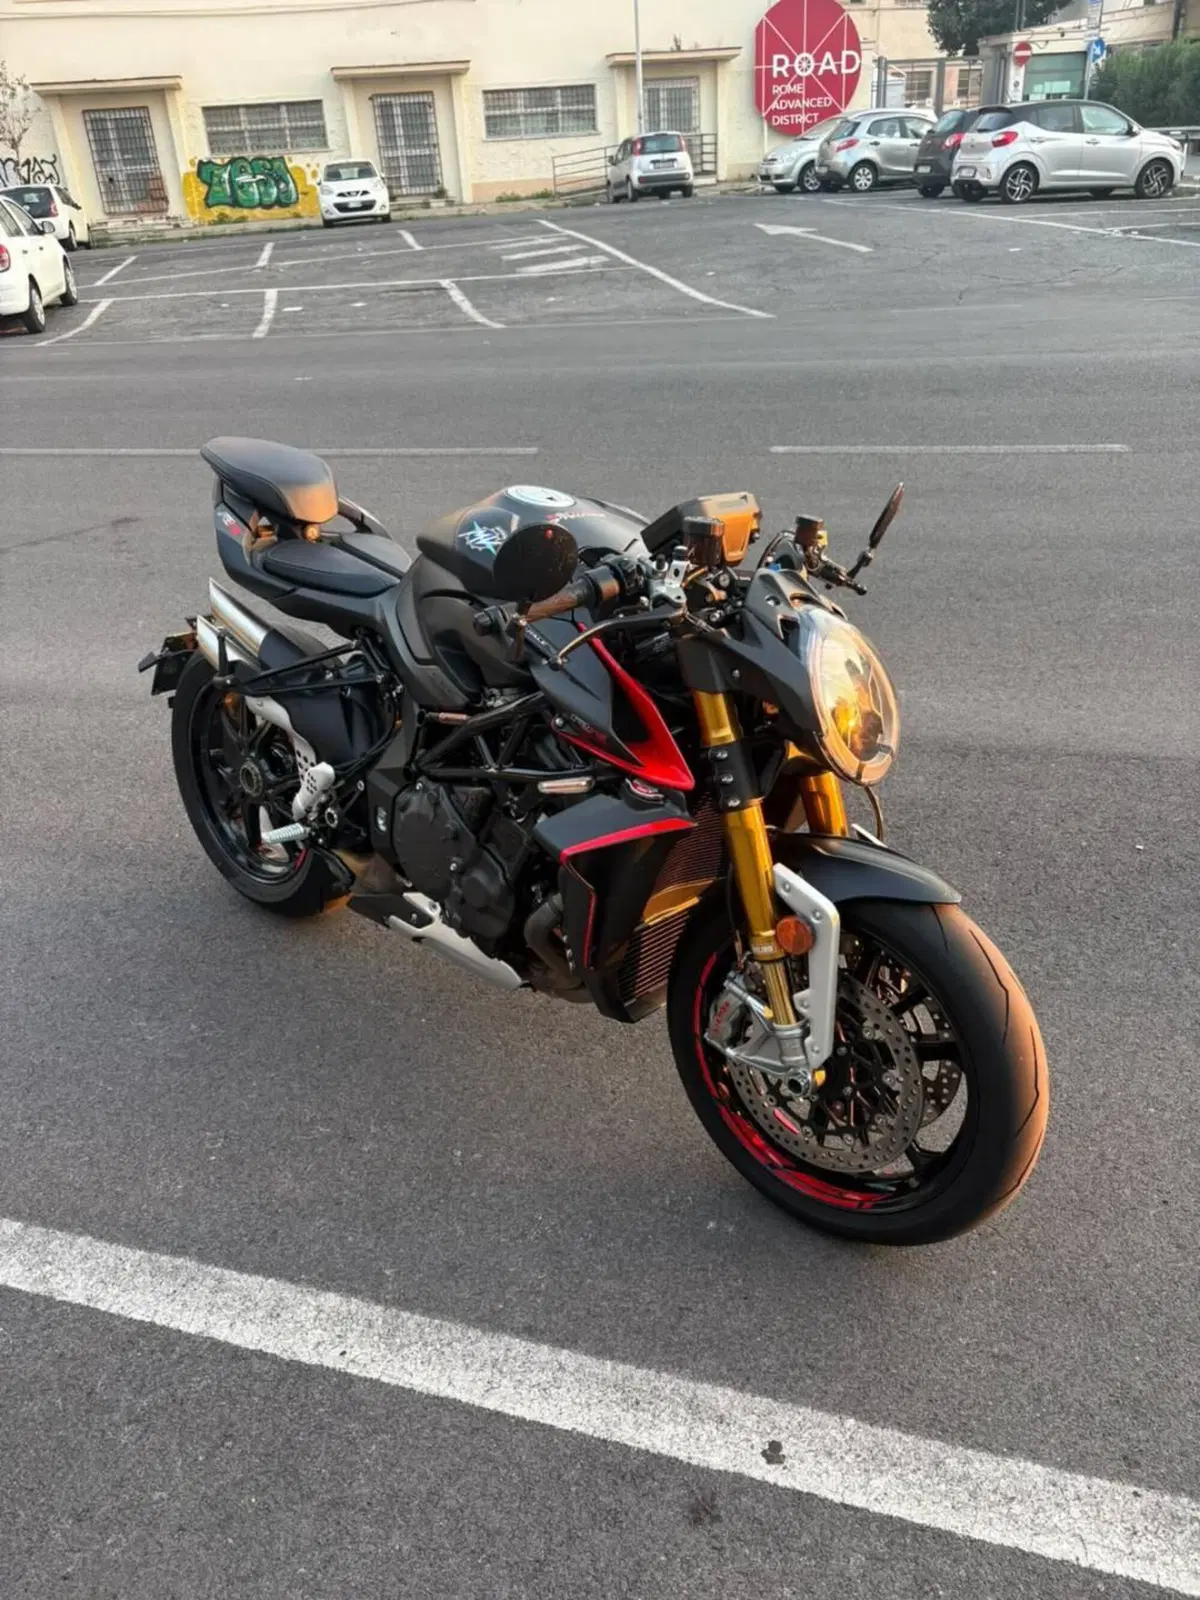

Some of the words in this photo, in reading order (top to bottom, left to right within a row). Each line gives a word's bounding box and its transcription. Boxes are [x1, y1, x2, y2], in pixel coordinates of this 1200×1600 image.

[772, 50, 860, 78] ROAD
[772, 83, 804, 95] ROME
[771, 97, 832, 110] ADVANCED
[772, 113, 819, 125] DISTRICT
